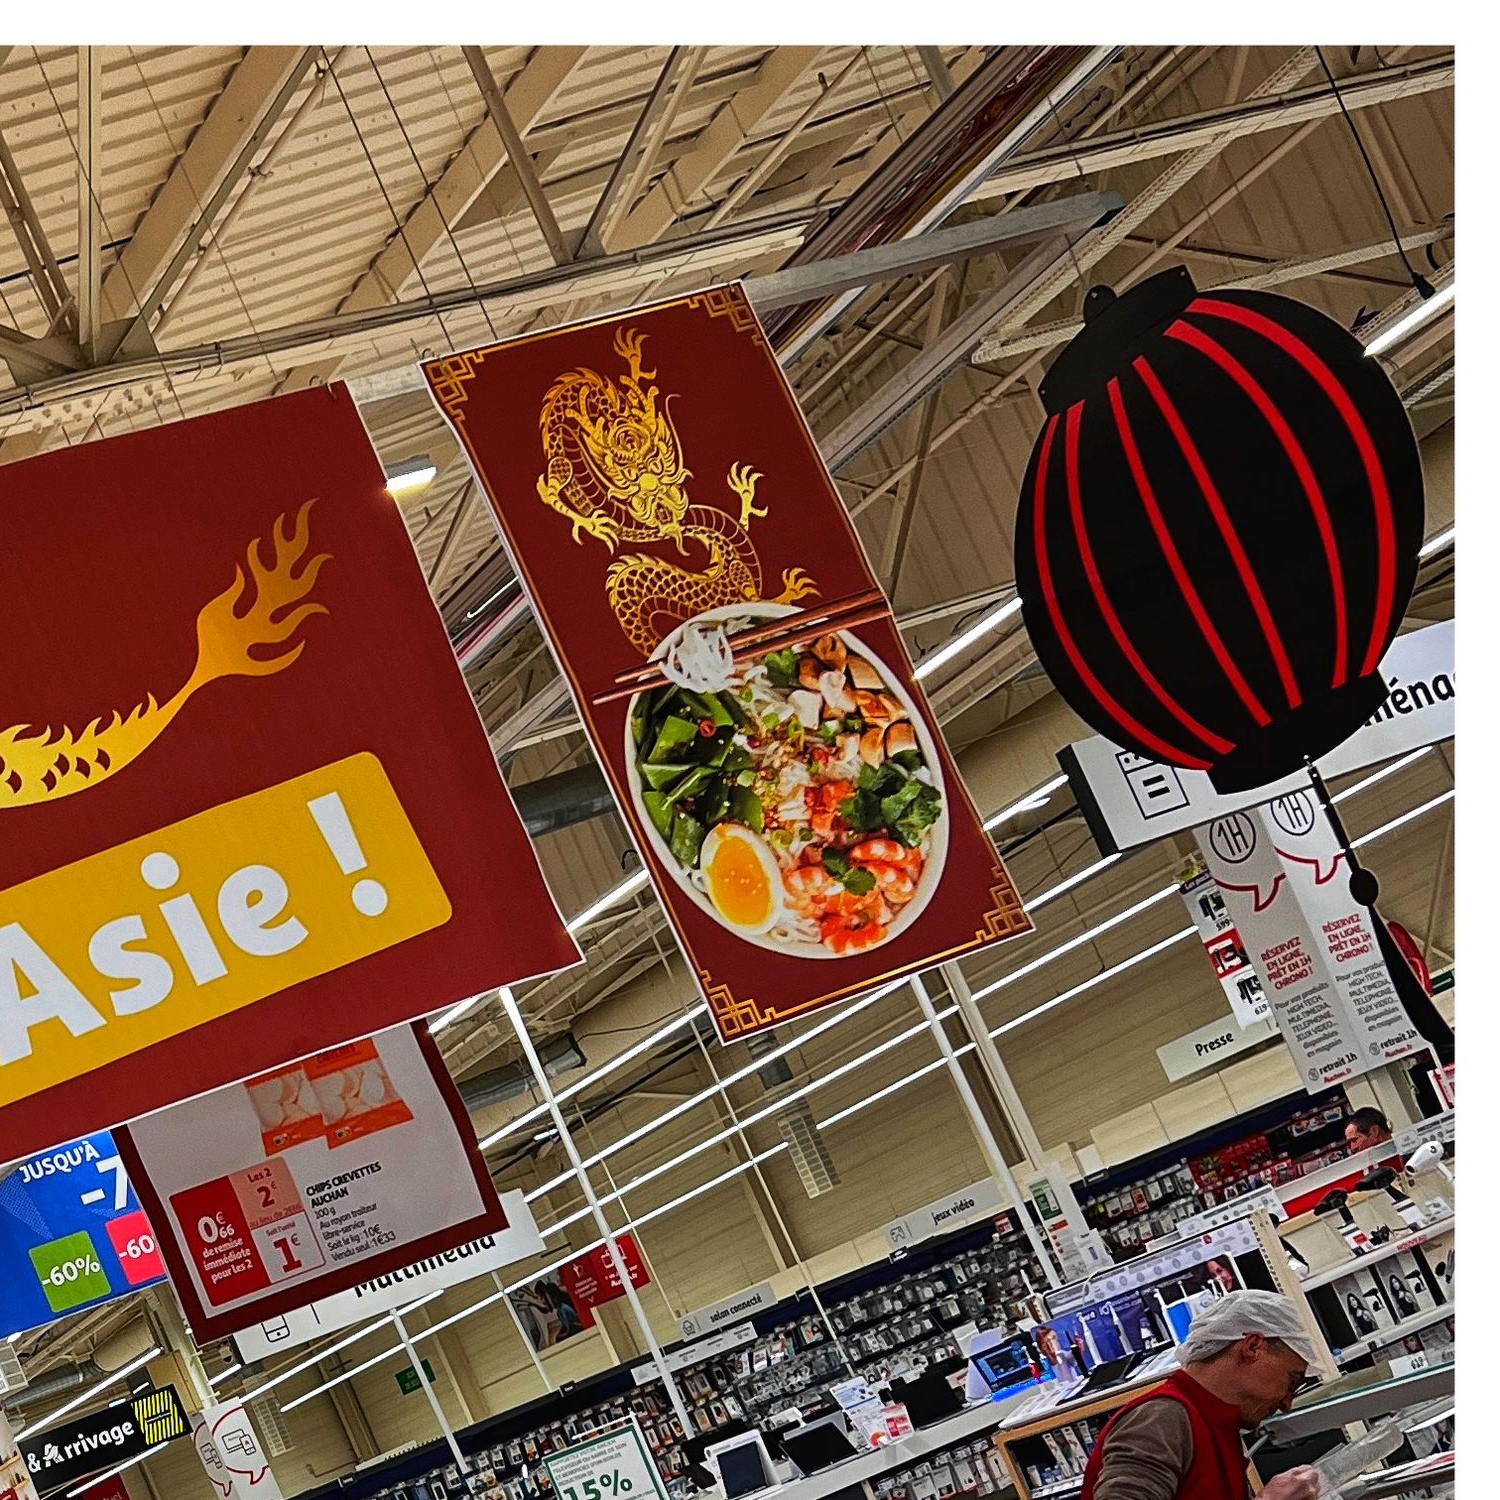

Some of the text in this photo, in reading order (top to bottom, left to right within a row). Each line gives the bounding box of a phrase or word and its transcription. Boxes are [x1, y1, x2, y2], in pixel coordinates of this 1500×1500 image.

[1217, 821, 1247, 857] 1H
[306, 791, 393, 919] !
[1328, 932, 1340, 943] EN
[1350, 936, 1361, 946] EN
[1336, 944, 1369, 962] CHRONO
[1275, 972, 1308, 990] CHRONO
[1194, 1032, 1235, 1056] Presse
[19, 1141, 101, 1184] JUSQU'À
[306, 1162, 381, 1196] CHIPS CREVETTES
[311, 1187, 349, 1208] AUCHAN
[932, 1197, 976, 1228] jeux vidéo
[214, 1237, 244, 1255] remise
[41, 1254, 101, 1288] -60%
[203, 1247, 251, 1271] immédiate
[211, 1267, 232, 1284] pour
[709, 1292, 764, 1324] salon connecté
[26, 1452, 42, 1473] &
